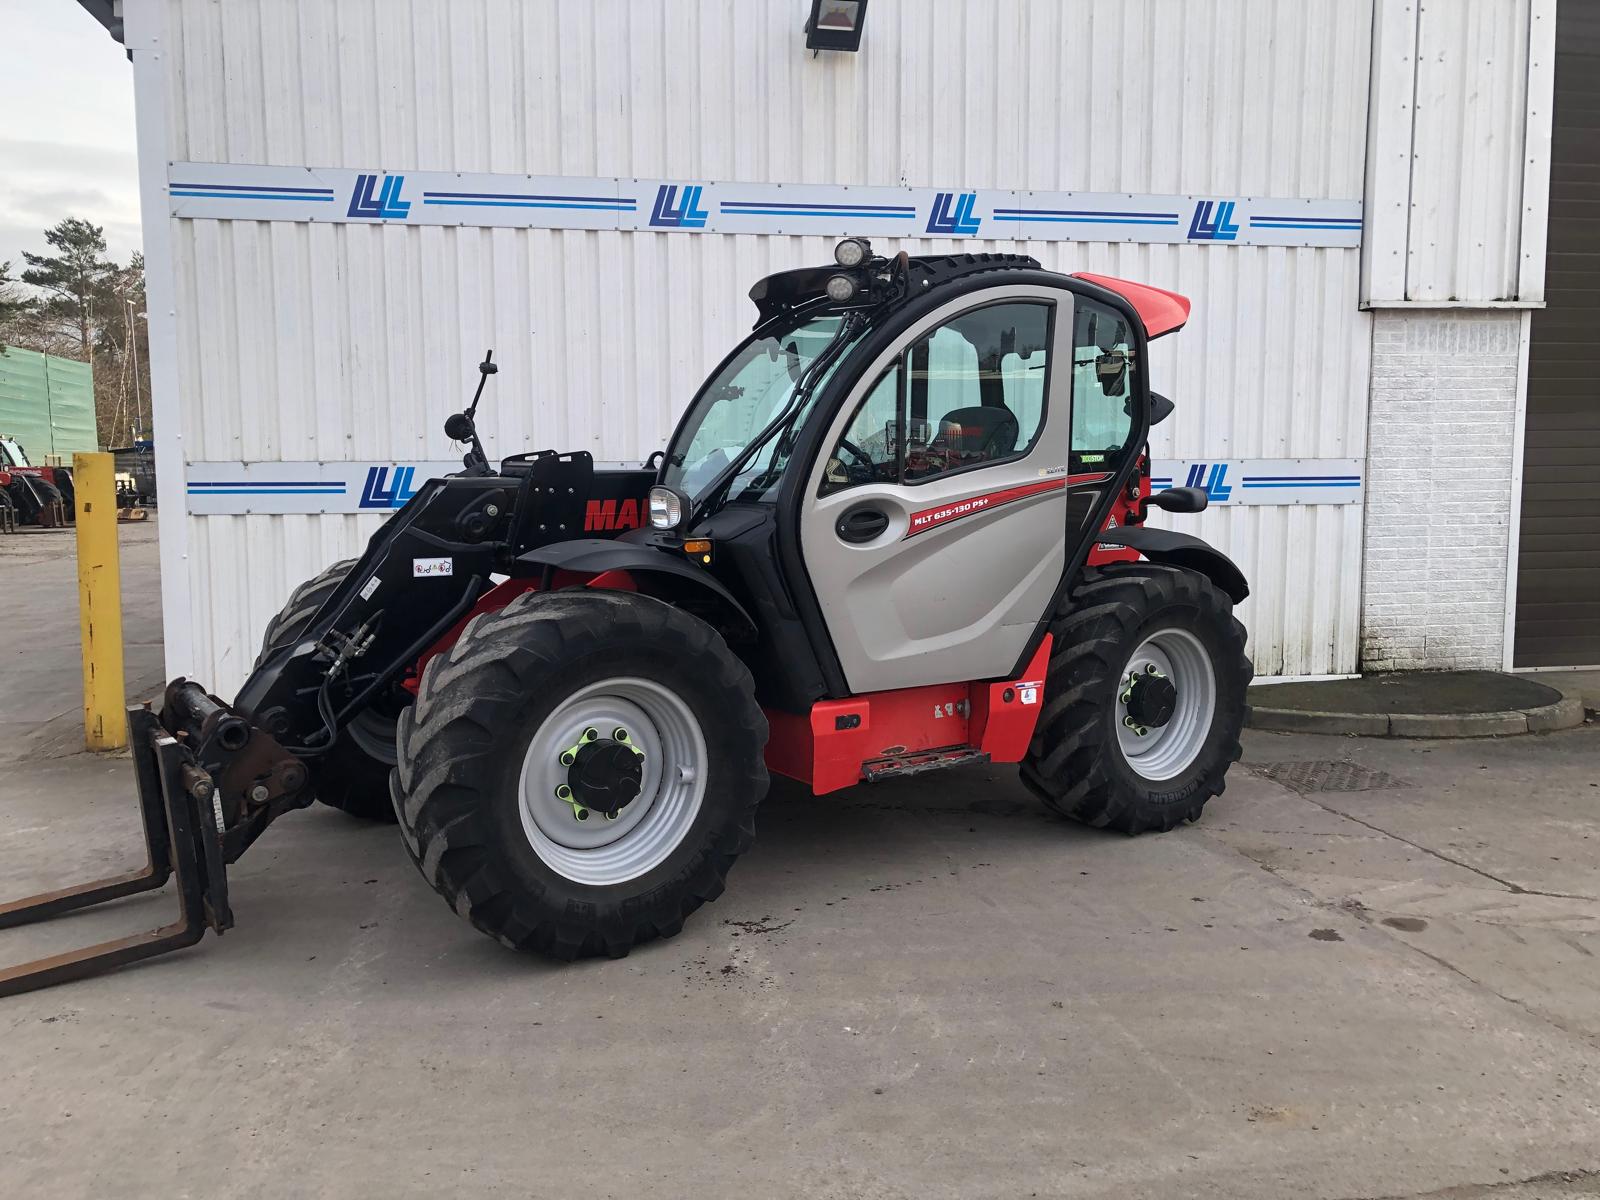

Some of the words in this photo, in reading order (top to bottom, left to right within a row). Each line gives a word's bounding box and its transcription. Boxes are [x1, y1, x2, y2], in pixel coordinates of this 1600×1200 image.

[914, 514, 933, 526] MLT
[933, 503, 971, 520] 635-130
[972, 498, 989, 509] PS+
